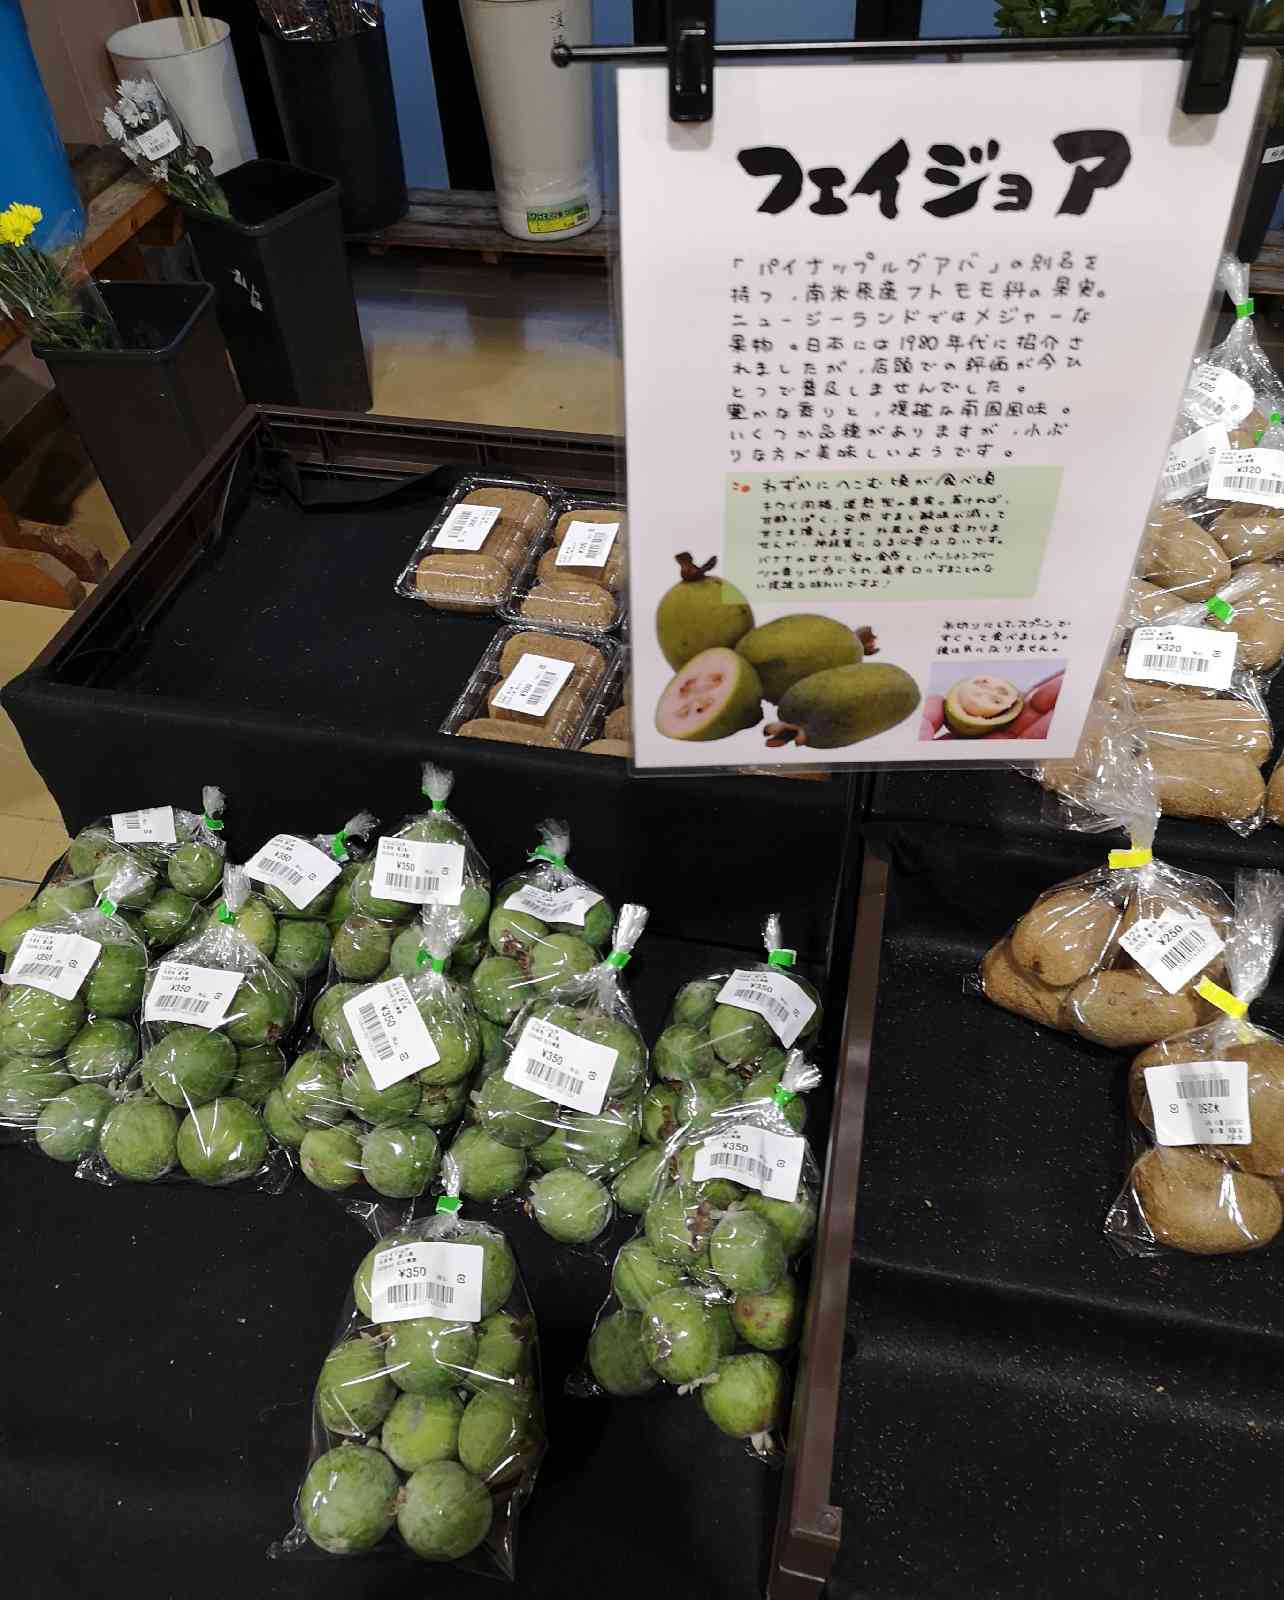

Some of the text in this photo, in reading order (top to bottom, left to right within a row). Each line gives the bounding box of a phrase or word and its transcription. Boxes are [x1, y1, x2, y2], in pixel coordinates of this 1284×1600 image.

[737, 130, 1131, 219] フェイジョア
[396, 861, 416, 873] ¥350
[1157, 924, 1184, 945] ¥250
[169, 983, 192, 993] ¥350
[541, 1047, 564, 1066] ¥350
[723, 1141, 749, 1153] ¥350
[398, 1266, 427, 1279] ¥350
